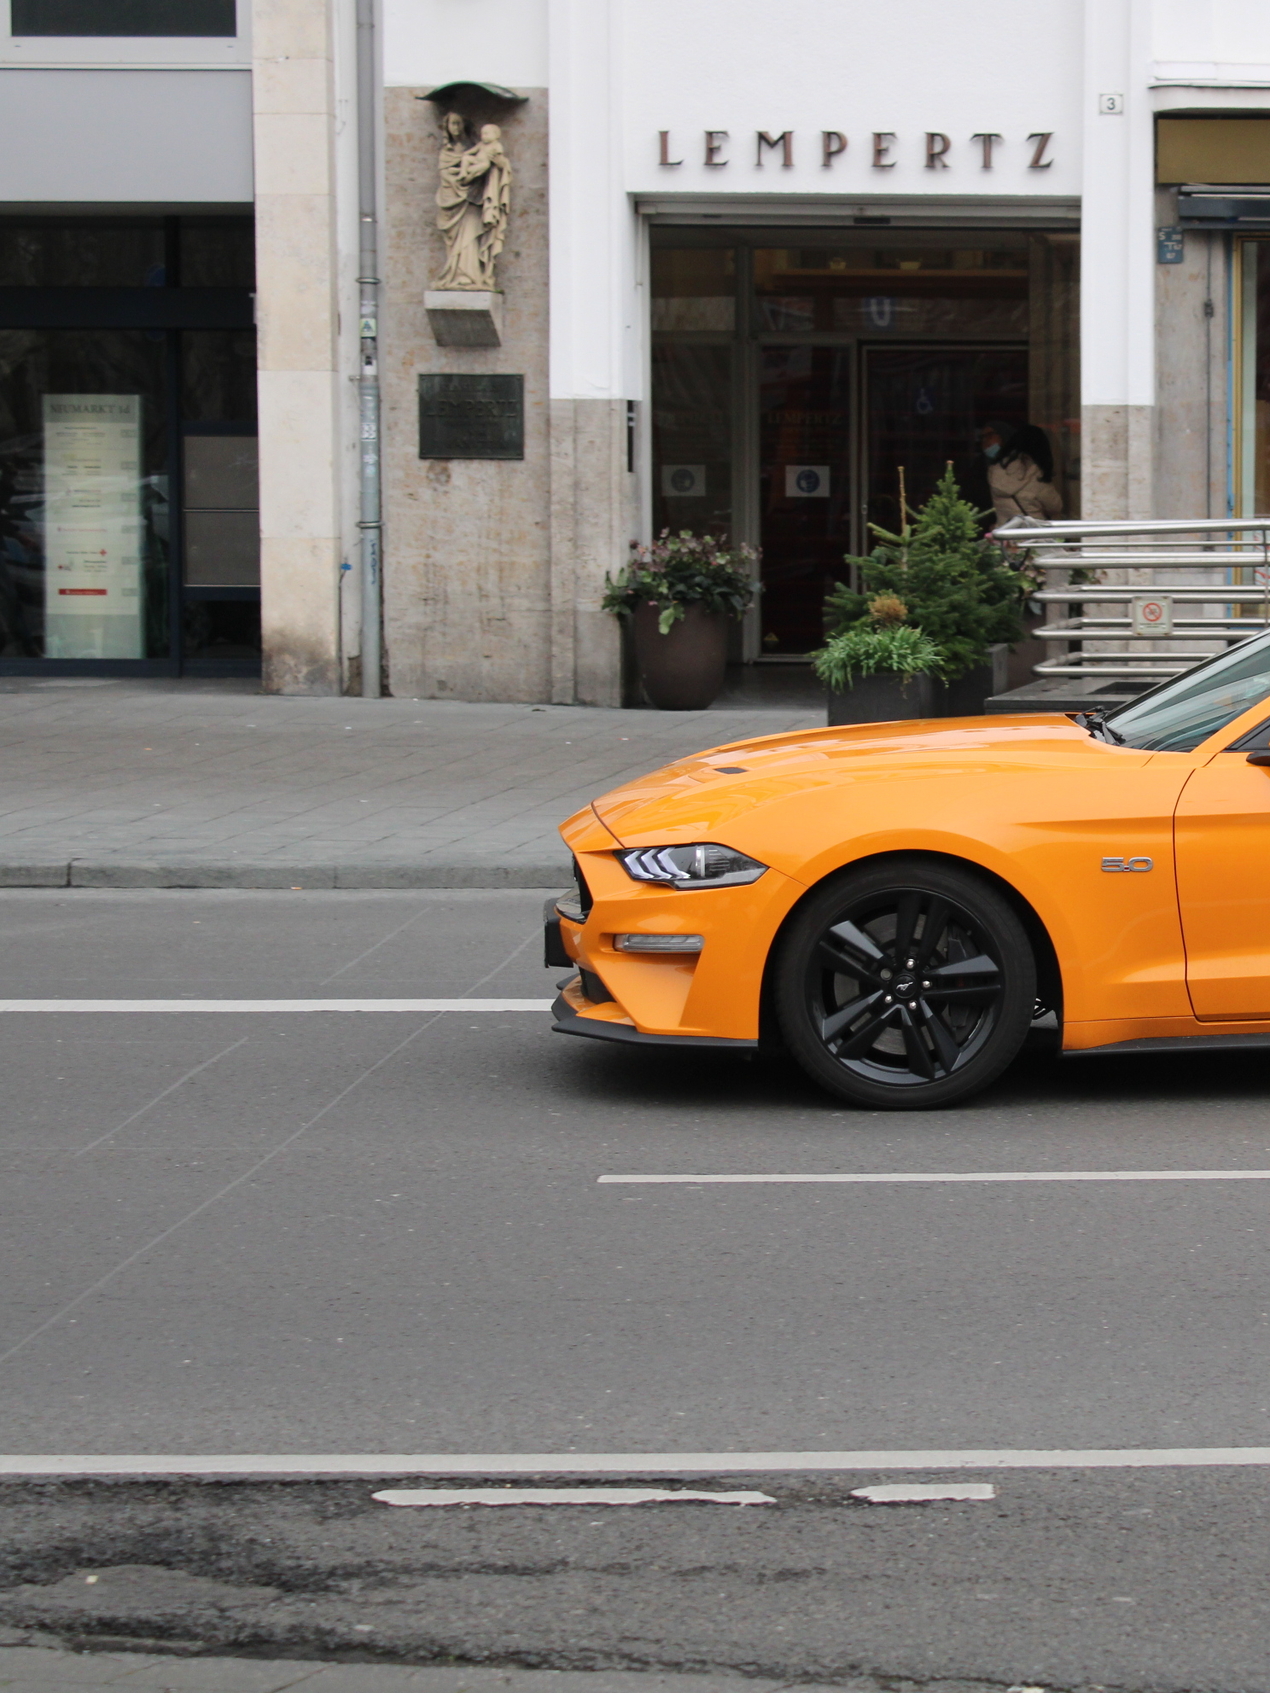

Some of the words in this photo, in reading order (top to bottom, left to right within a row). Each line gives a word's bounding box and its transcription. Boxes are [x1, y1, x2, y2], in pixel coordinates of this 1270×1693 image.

[1106, 97, 1116, 110] 3
[657, 130, 1055, 170] LEMPERTZ
[1101, 856, 1154, 872] 5.0
